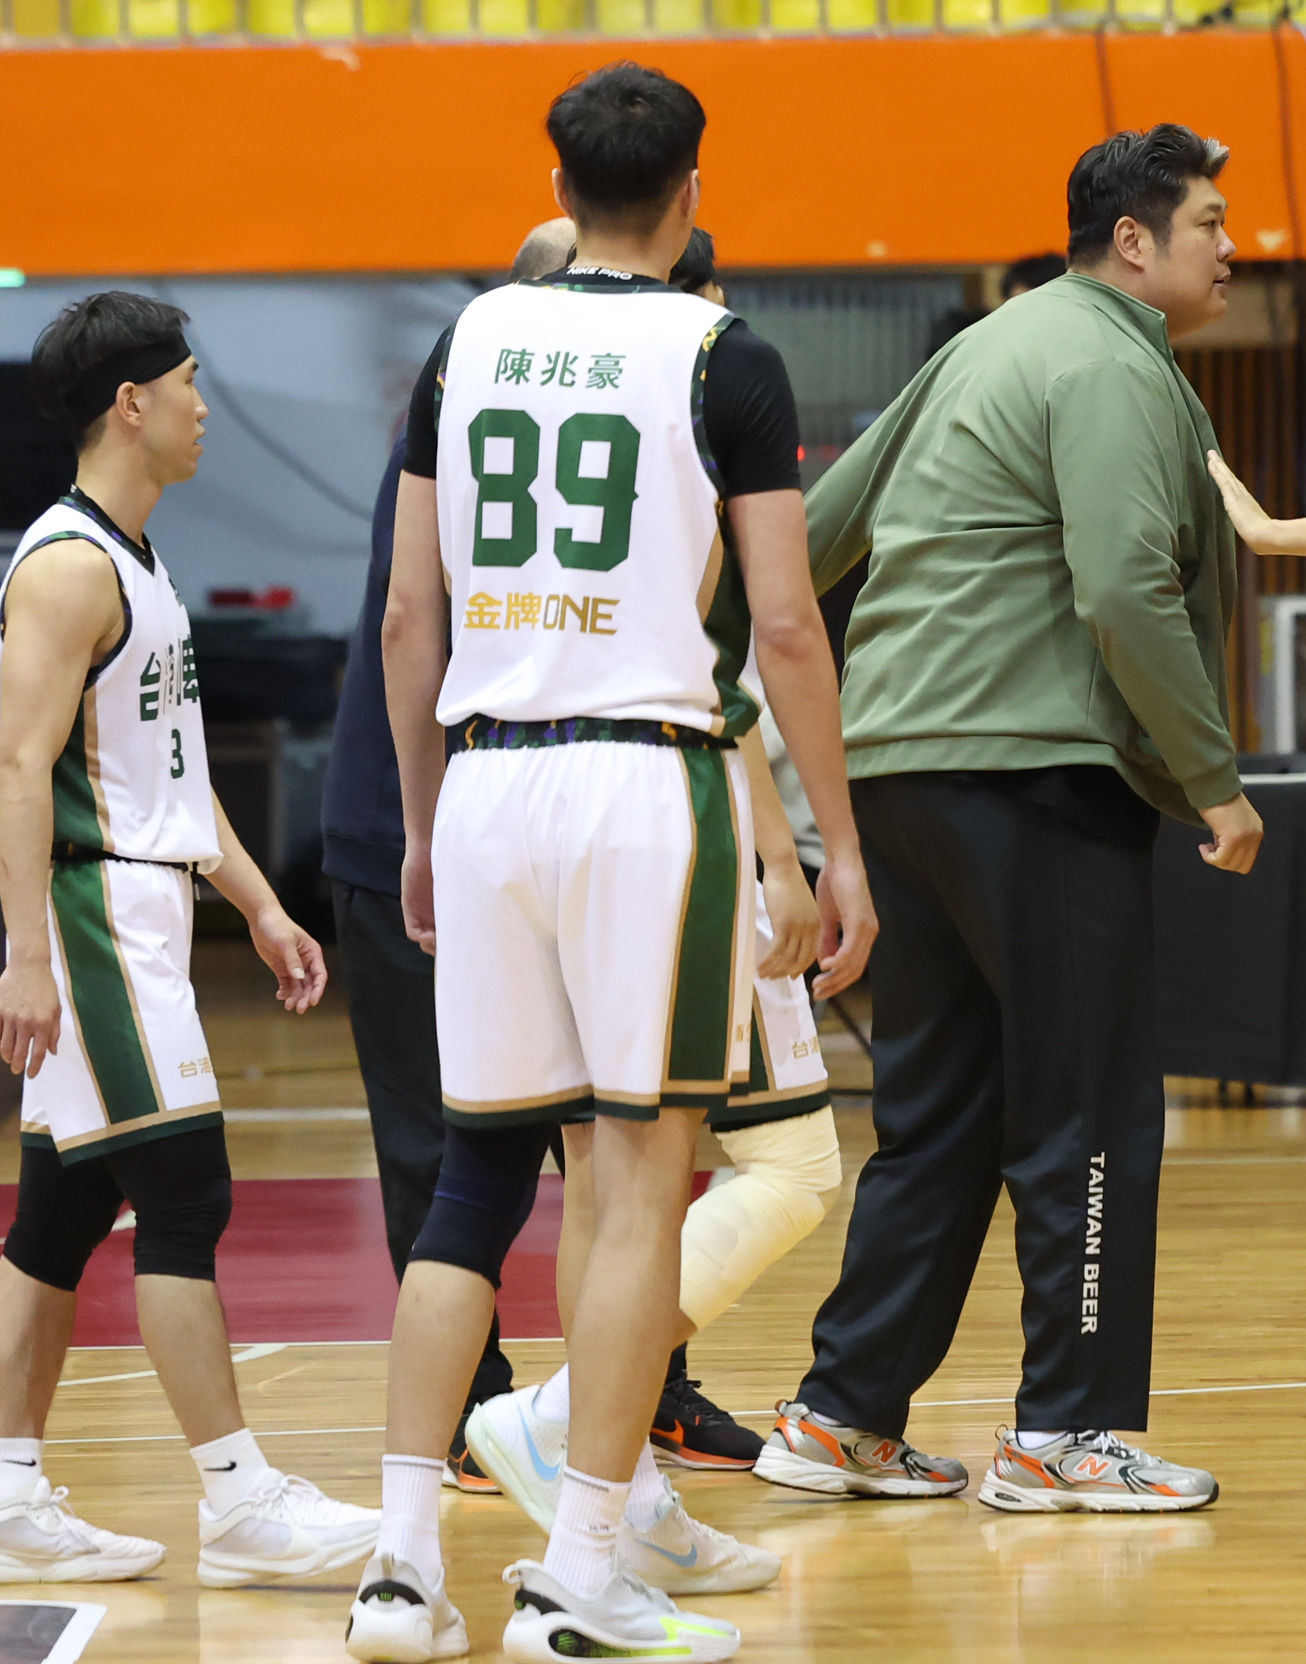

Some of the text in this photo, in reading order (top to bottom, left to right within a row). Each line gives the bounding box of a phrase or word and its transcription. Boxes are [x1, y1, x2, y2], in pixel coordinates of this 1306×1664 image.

[566, 266, 633, 280] NIKE PRO
[494, 348, 627, 390] 陳兆豪
[467, 408, 641, 572] 89
[463, 591, 621, 636] 金牌ONE
[170, 728, 185, 779] 3
[1081, 1151, 1106, 1334] TAIWAN BEER
